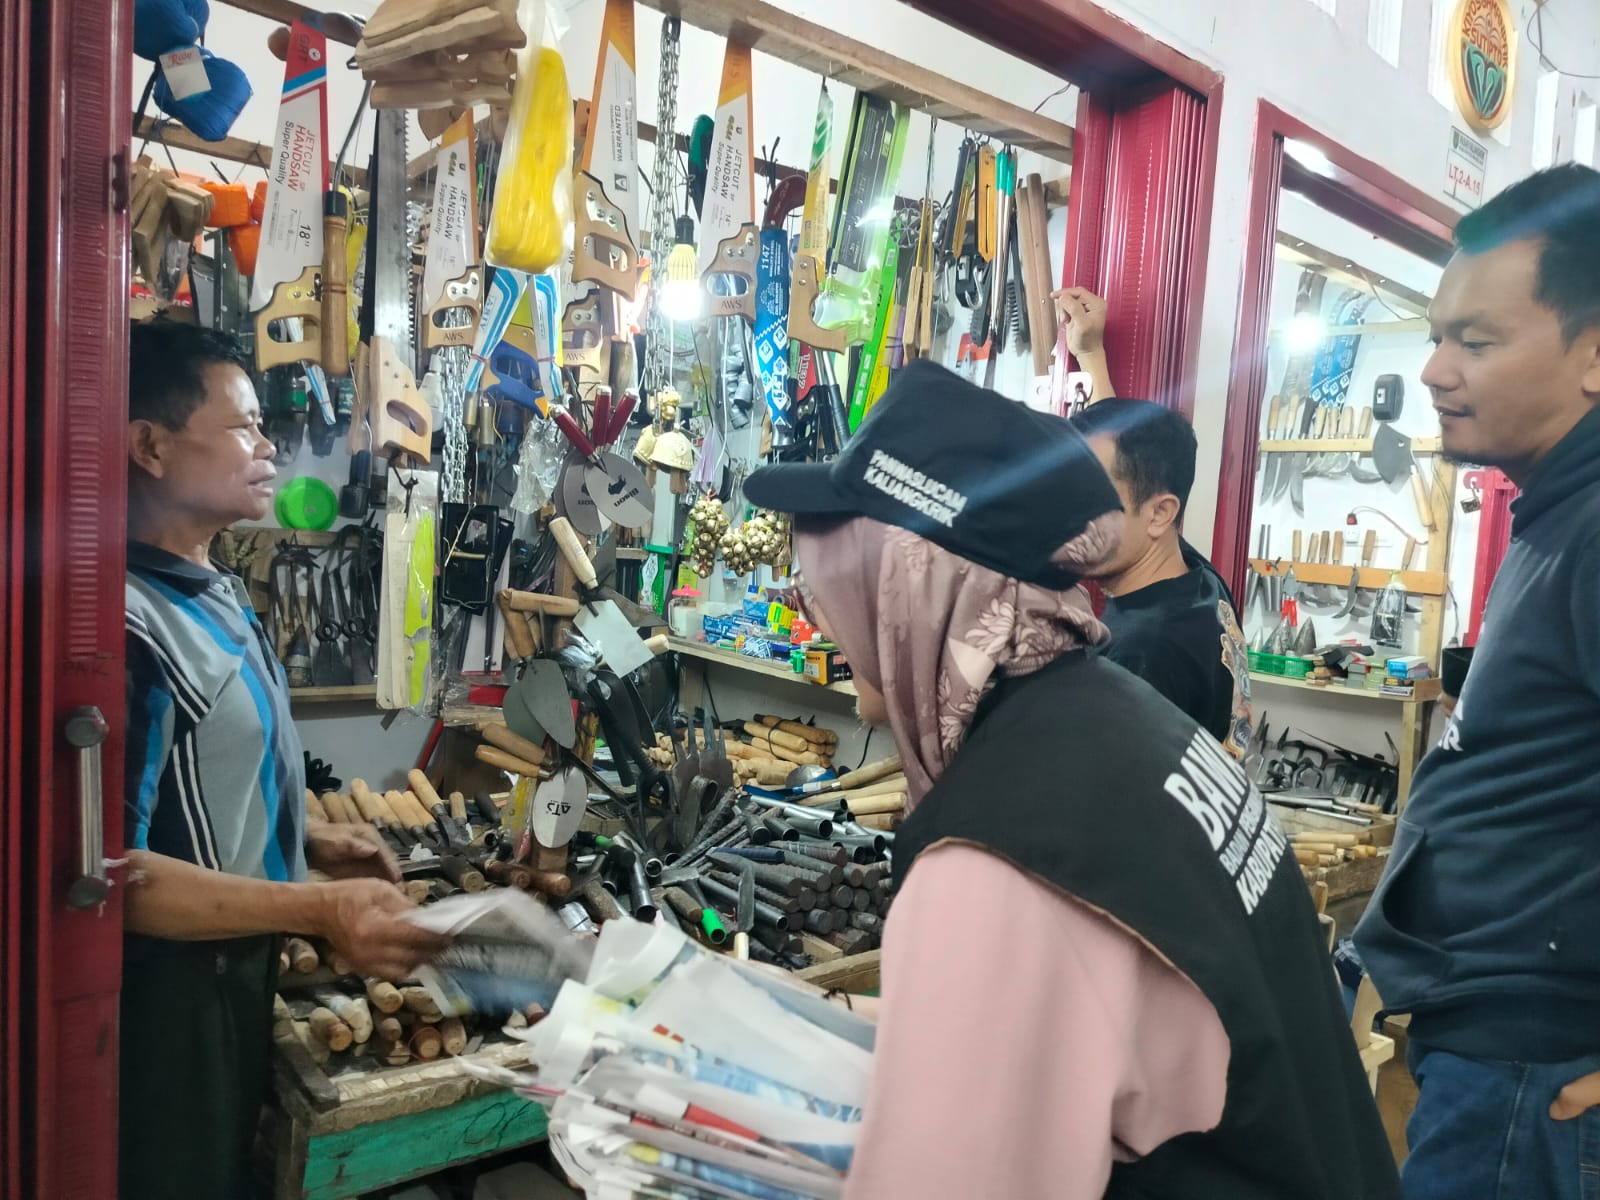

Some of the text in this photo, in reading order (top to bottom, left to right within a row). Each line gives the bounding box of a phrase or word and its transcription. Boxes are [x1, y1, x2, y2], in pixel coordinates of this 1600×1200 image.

[275, 120, 295, 185] Super Quality
[302, 129, 316, 176] JETCUT
[615, 104, 623, 162] WARRANTED
[716, 141, 725, 166] Super
[287, 124, 307, 193] HANDSAW
[711, 166, 722, 194] Quality
[720, 144, 734, 200] HANDSAW
[732, 149, 743, 192] JETCUT
[438, 182, 448, 206] Super
[444, 185, 458, 241] HANDSAW
[456, 189, 468, 229] JETCUT
[761, 244, 770, 271] 1147
[721, 299, 743, 310] AWS
[443, 332, 464, 342] AWS
[566, 352, 586, 361] AWS
[863, 465, 959, 528] KALIANGKRIK
[1219, 827, 1250, 877] BADAN
